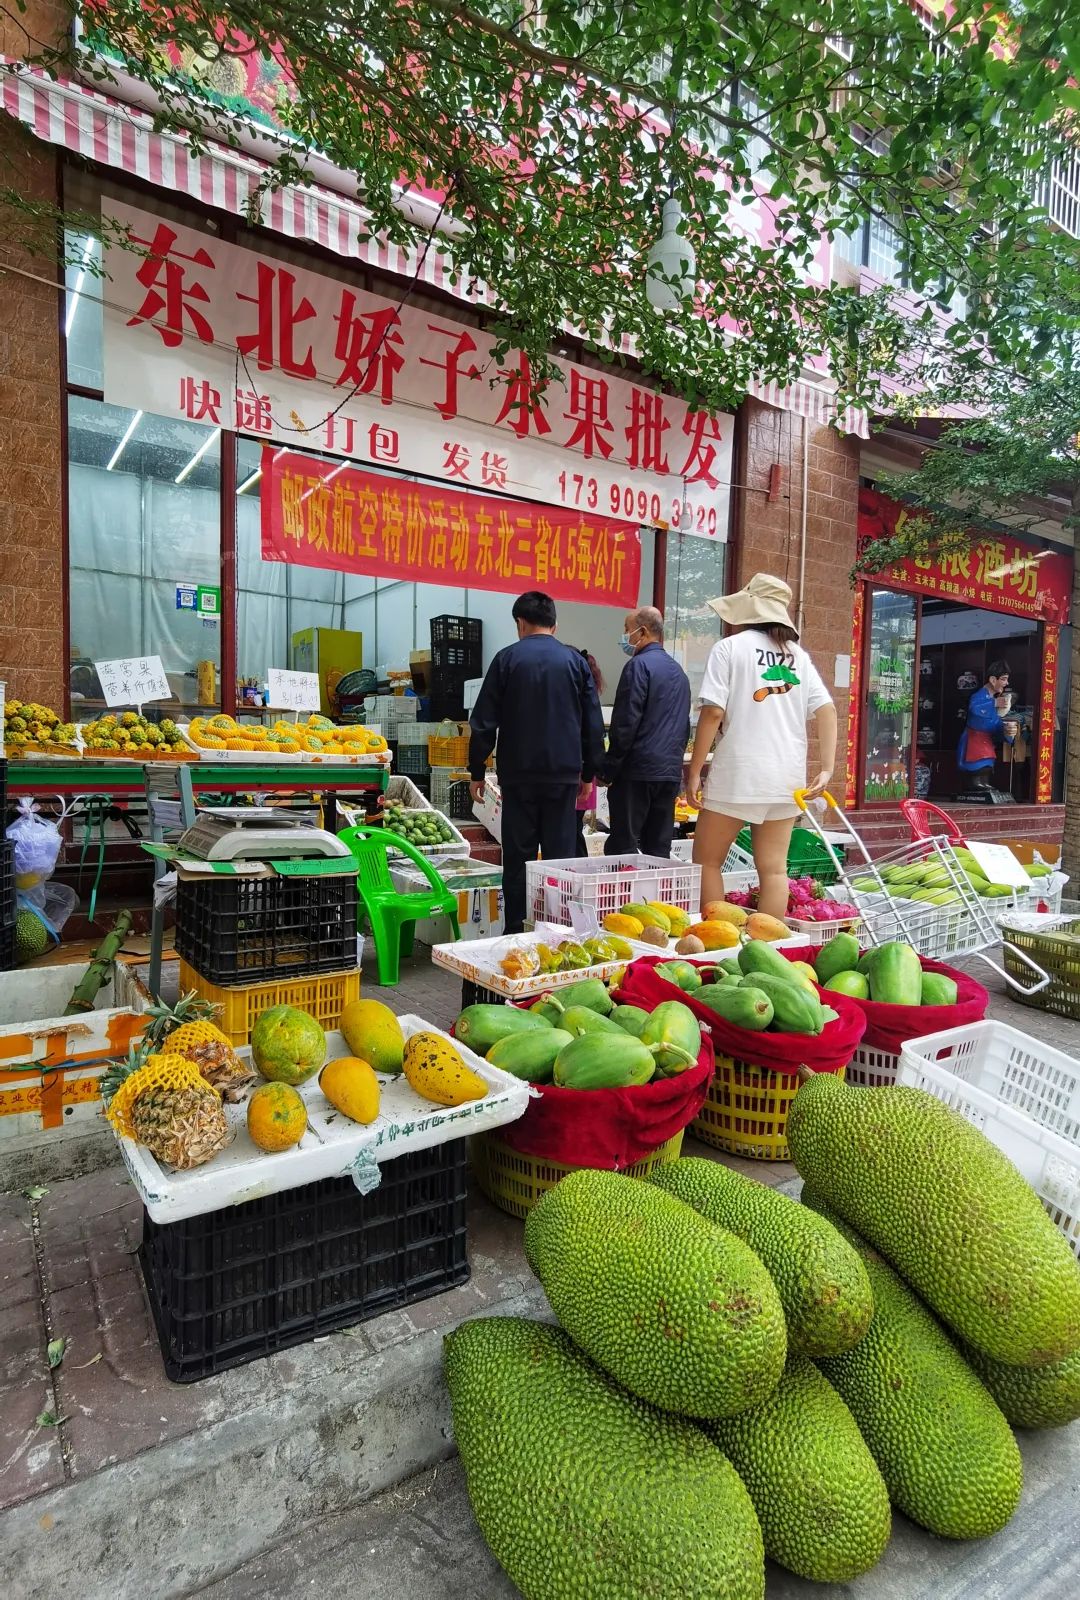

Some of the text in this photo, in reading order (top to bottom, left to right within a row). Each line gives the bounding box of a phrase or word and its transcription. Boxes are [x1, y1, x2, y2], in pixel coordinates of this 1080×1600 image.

[126, 222, 722, 490] 东北娇子水果批发
[179, 376, 273, 435] 快递
[322, 411, 400, 463] 打包
[442, 442, 509, 489] 发货
[558, 471, 598, 509] 173
[610, 484, 661, 521] 9090
[1039, 651, 1056, 781] 知己相逢千杯少
